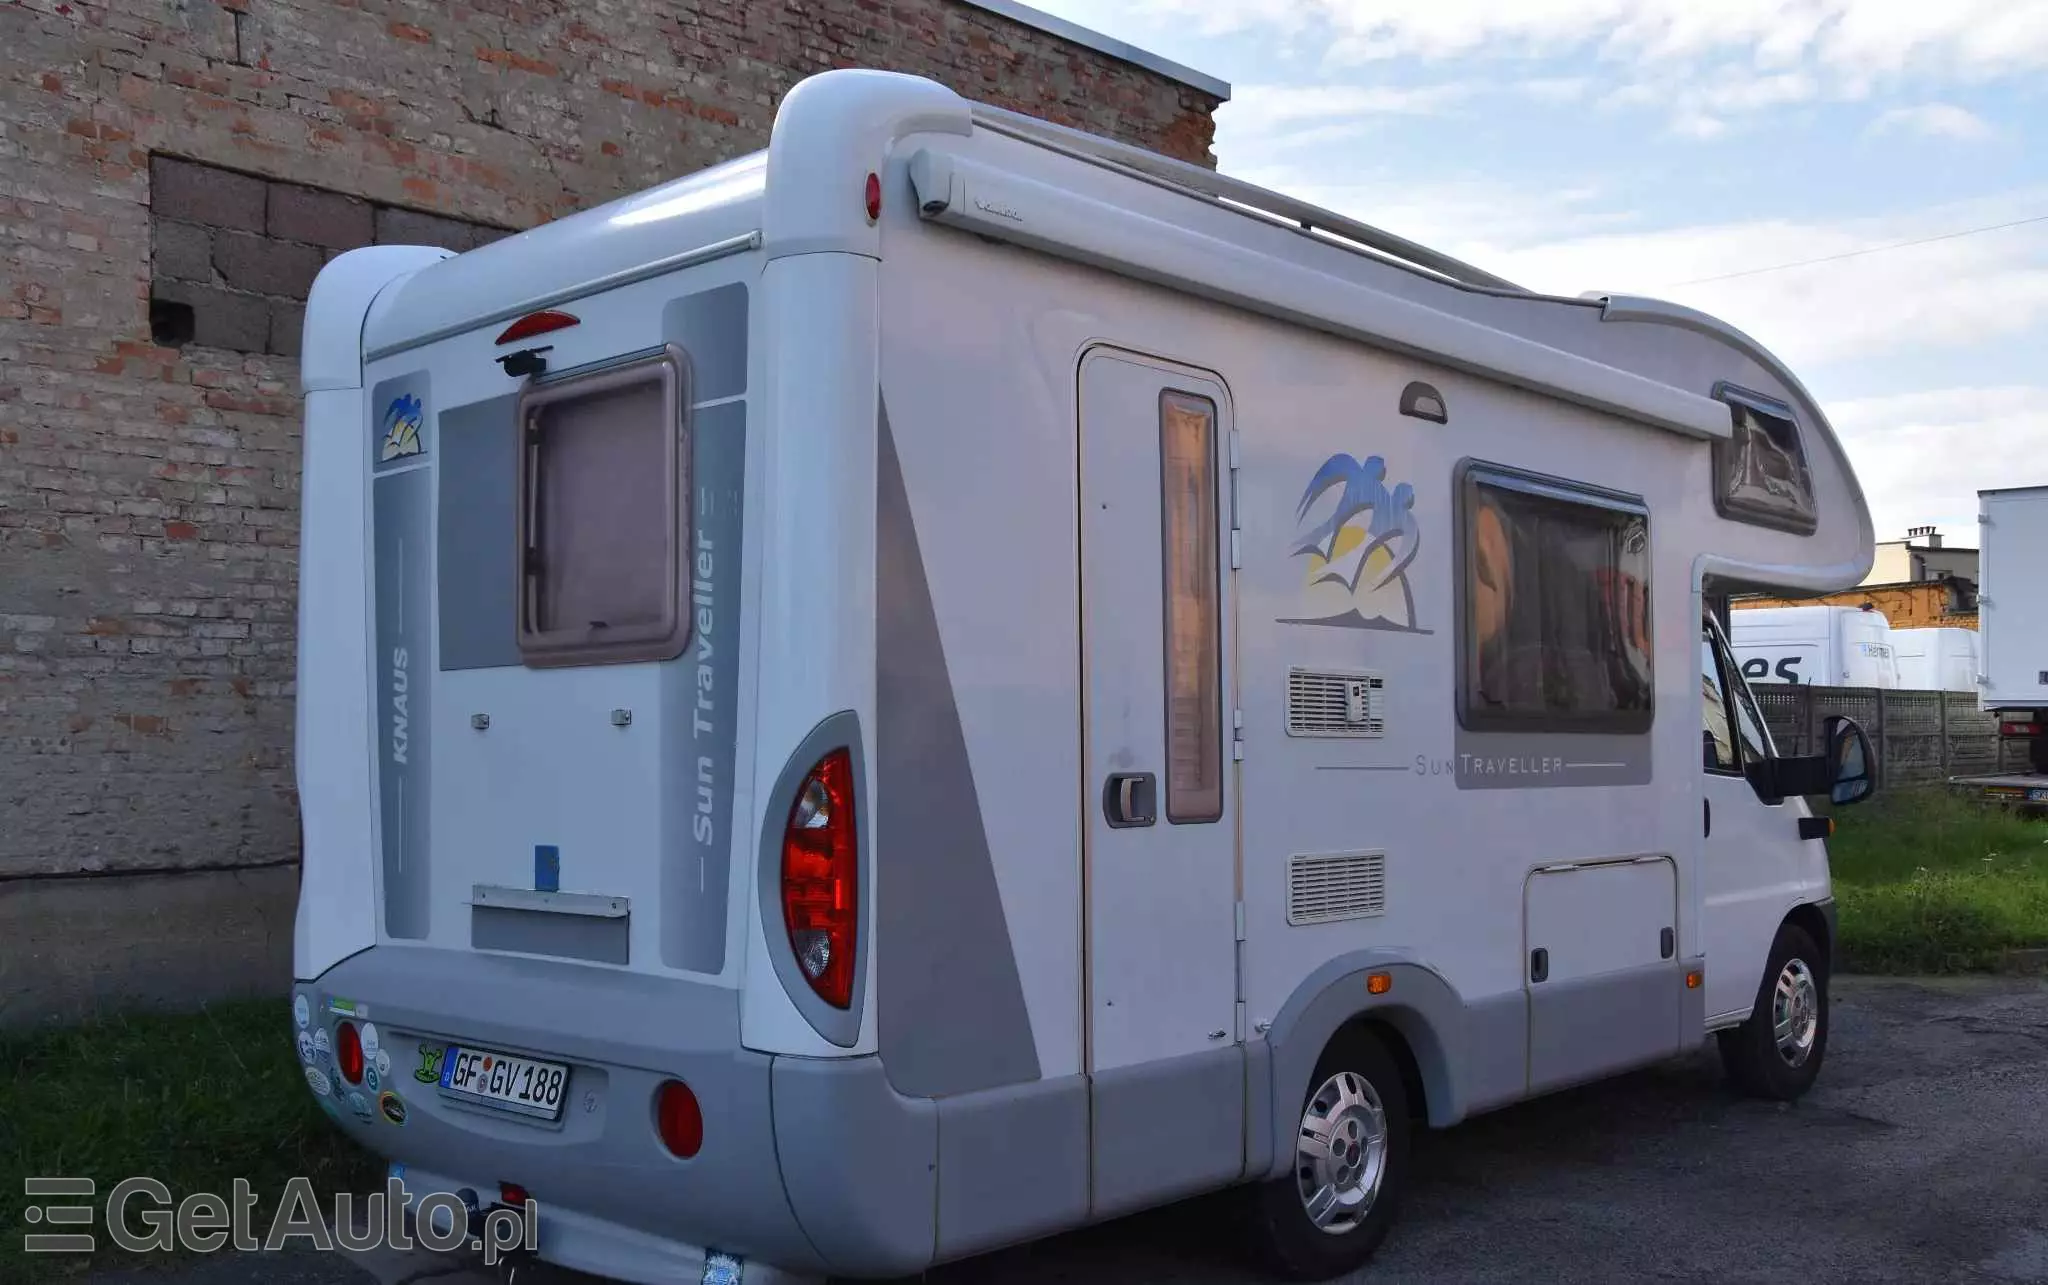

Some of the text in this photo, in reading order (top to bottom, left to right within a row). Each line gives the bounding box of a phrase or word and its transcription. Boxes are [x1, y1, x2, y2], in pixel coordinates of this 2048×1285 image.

[392, 647, 408, 765] KNAUS
[692, 528, 714, 846] Sun Traveller
[1460, 753, 1562, 775] TRAVELLER
[453, 1053, 563, 1105] GF GV 188
